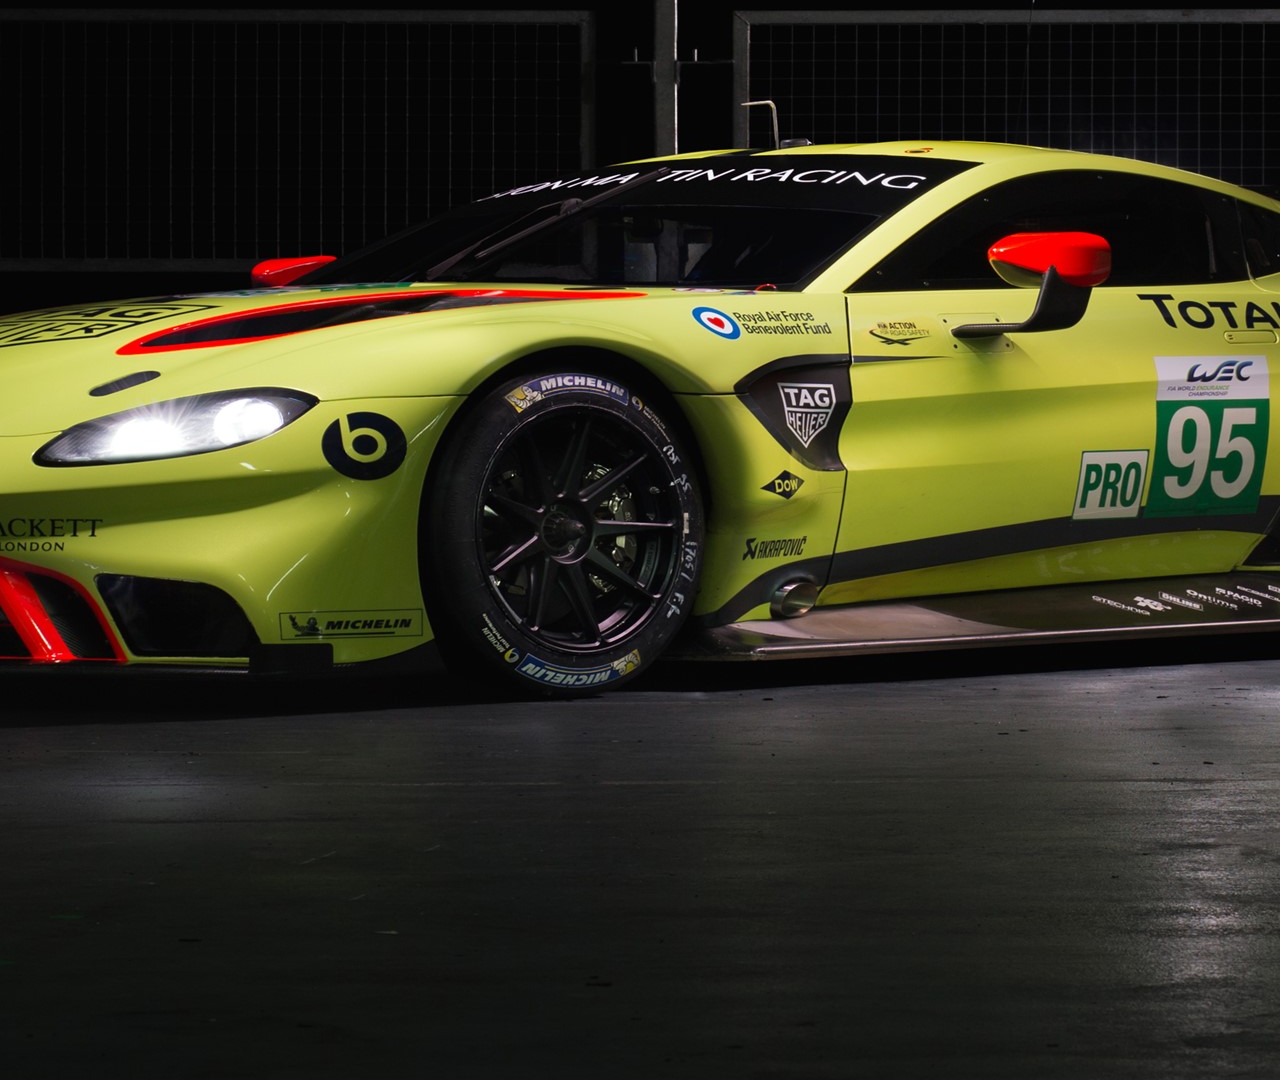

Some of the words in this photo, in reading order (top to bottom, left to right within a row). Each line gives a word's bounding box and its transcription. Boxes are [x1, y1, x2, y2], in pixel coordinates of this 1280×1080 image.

[567, 168, 736, 189] MATIN
[730, 168, 927, 190] RACING
[732, 311, 767, 324] Royal
[765, 310, 781, 322] Air
[780, 310, 815, 322] Force
[889, 322, 917, 330] ACTION
[741, 323, 805, 335] Benevolent
[802, 322, 833, 335] Fund
[1186, 360, 1254, 383] WEC
[539, 376, 625, 398] MICHELIN
[783, 387, 830, 408] TAG
[788, 411, 827, 442] HEUER
[1162, 405, 1258, 500] 95
[1079, 461, 1142, 509] PRO
[1225, 589, 1263, 606] PAGID
[324, 618, 413, 631] MICHELIN
[520, 662, 612, 686] MICHELIN
